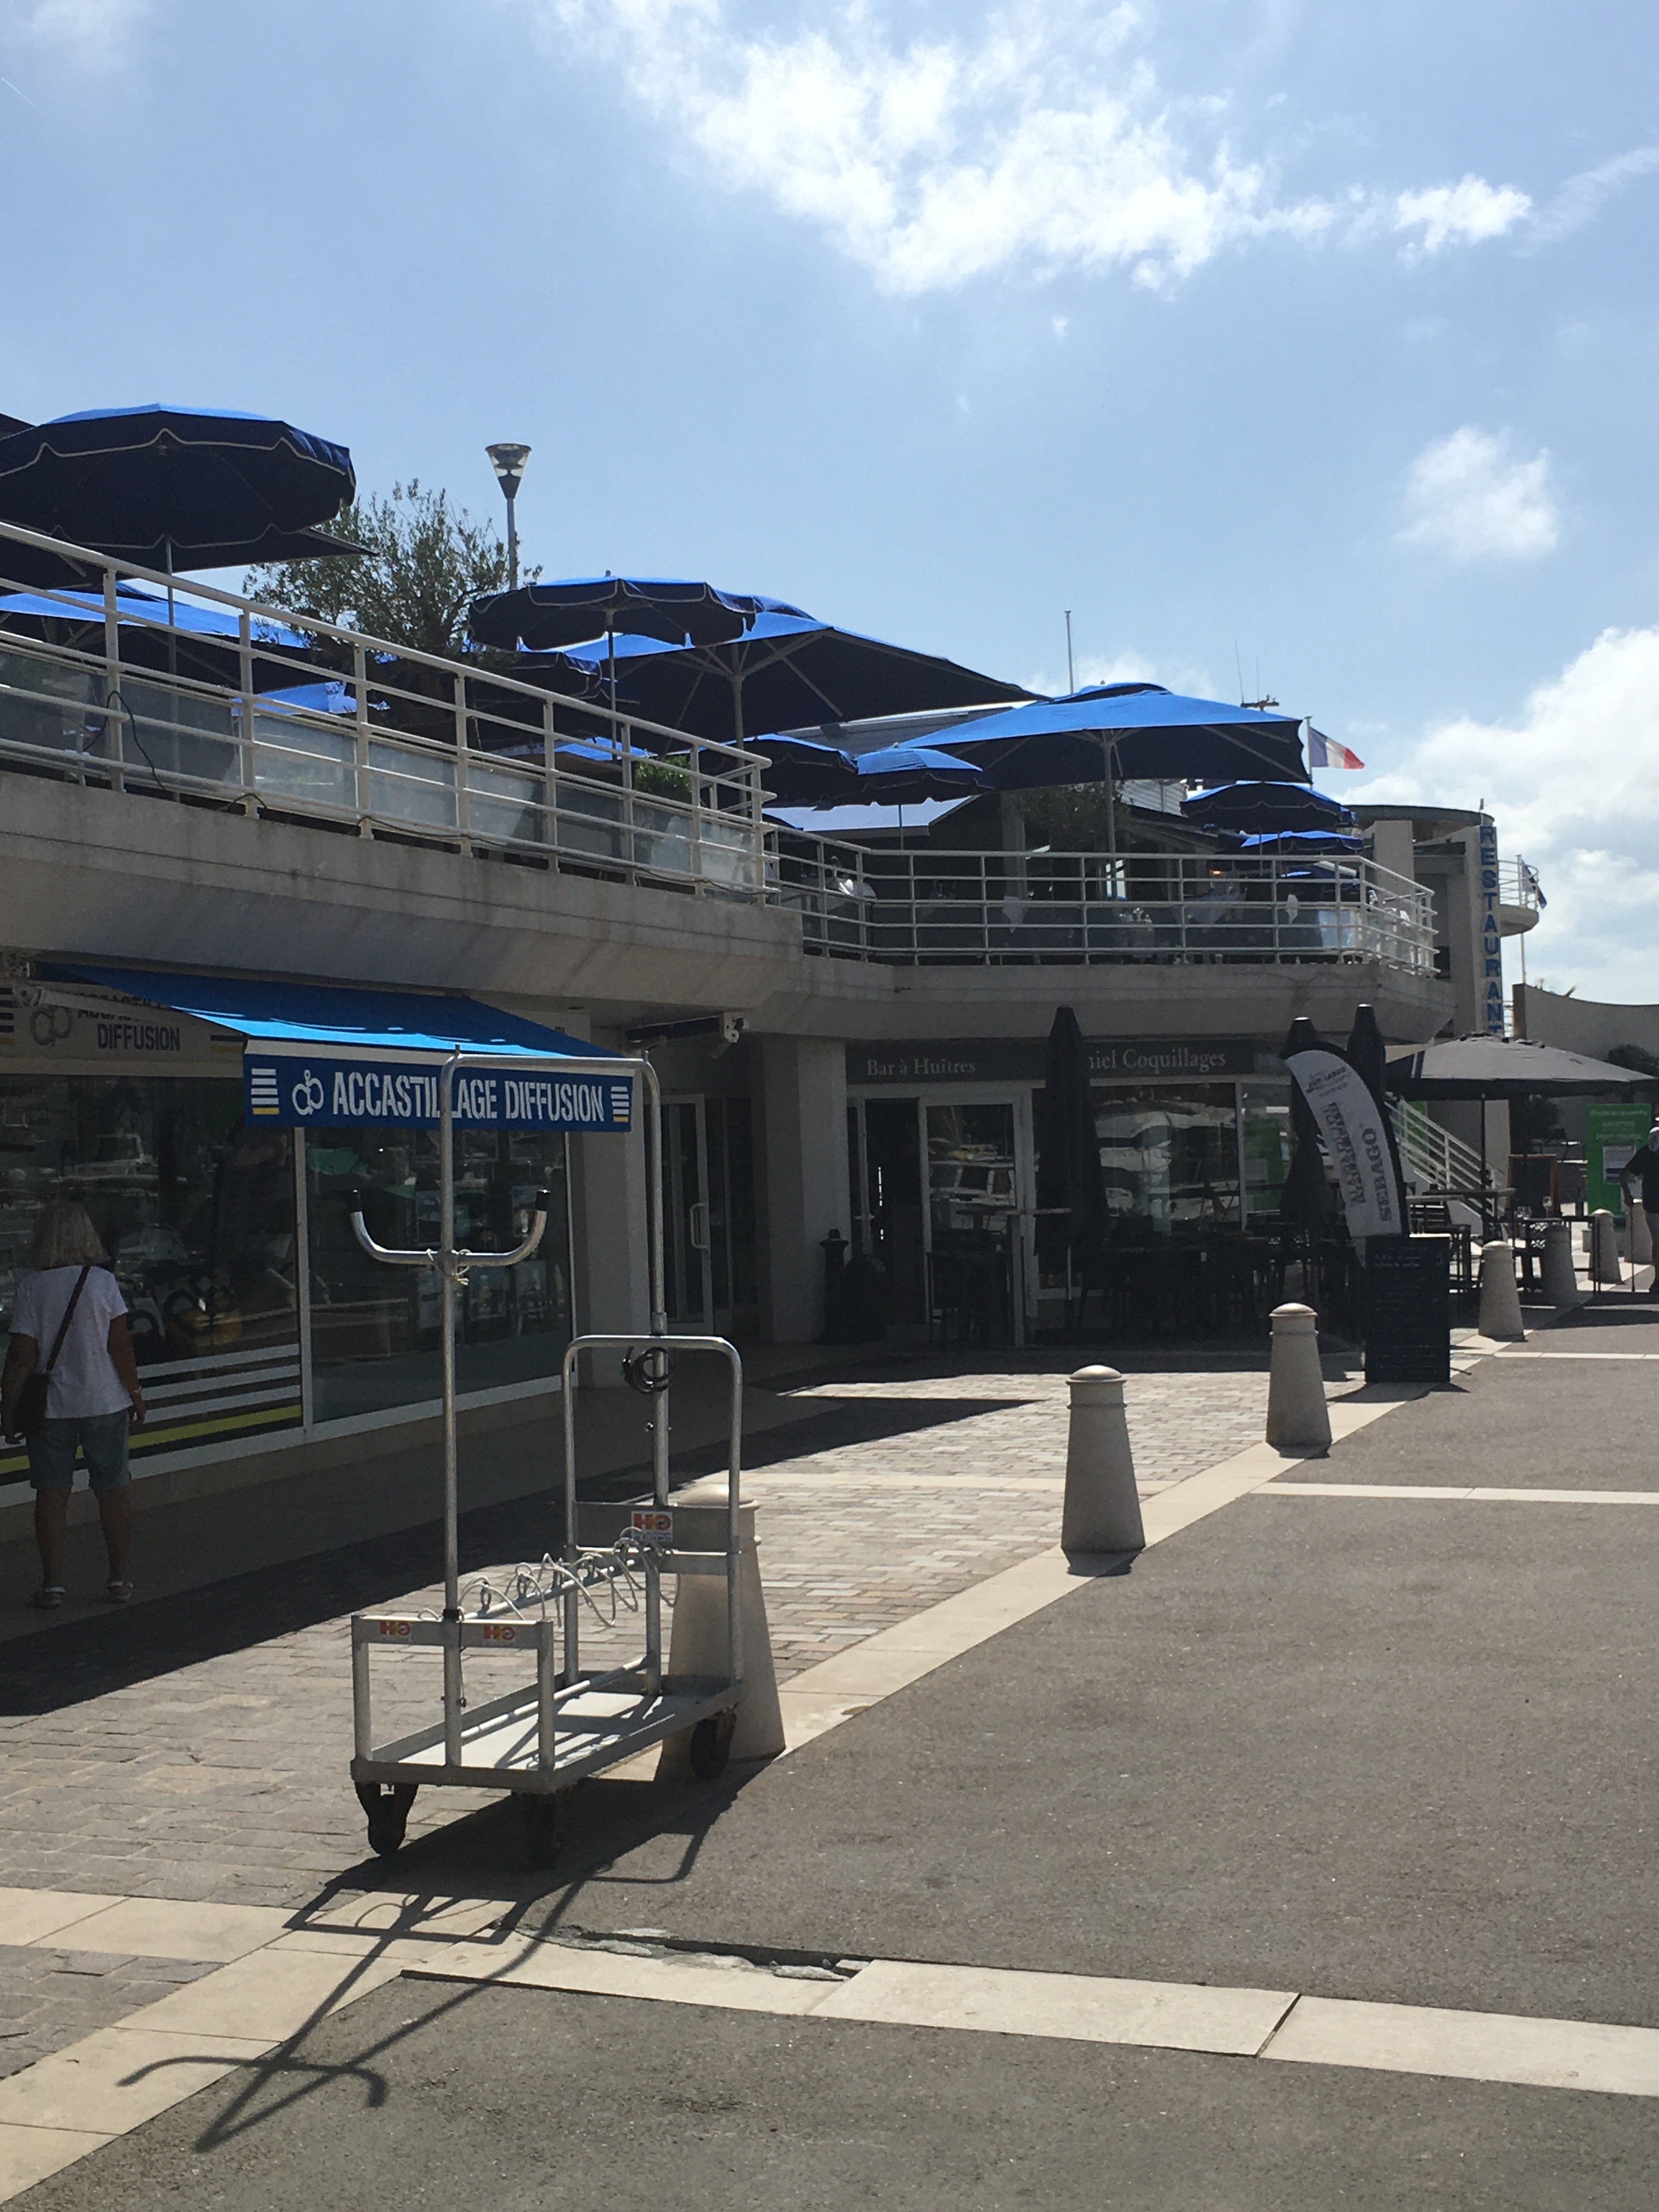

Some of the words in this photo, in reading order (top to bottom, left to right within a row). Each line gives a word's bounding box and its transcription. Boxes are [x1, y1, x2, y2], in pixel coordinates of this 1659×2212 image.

[98, 1023, 180, 1051] DIFFUSION
[867, 1059, 895, 1076] Bar
[899, 1057, 908, 1075] à
[913, 1058, 975, 1074] Huîtres
[1088, 1048, 1117, 1070] niel
[1122, 1047, 1226, 1074] Coquillages
[504, 1079, 605, 1122] DIFFUSION
[1362, 1127, 1392, 1222] SEBAGO
